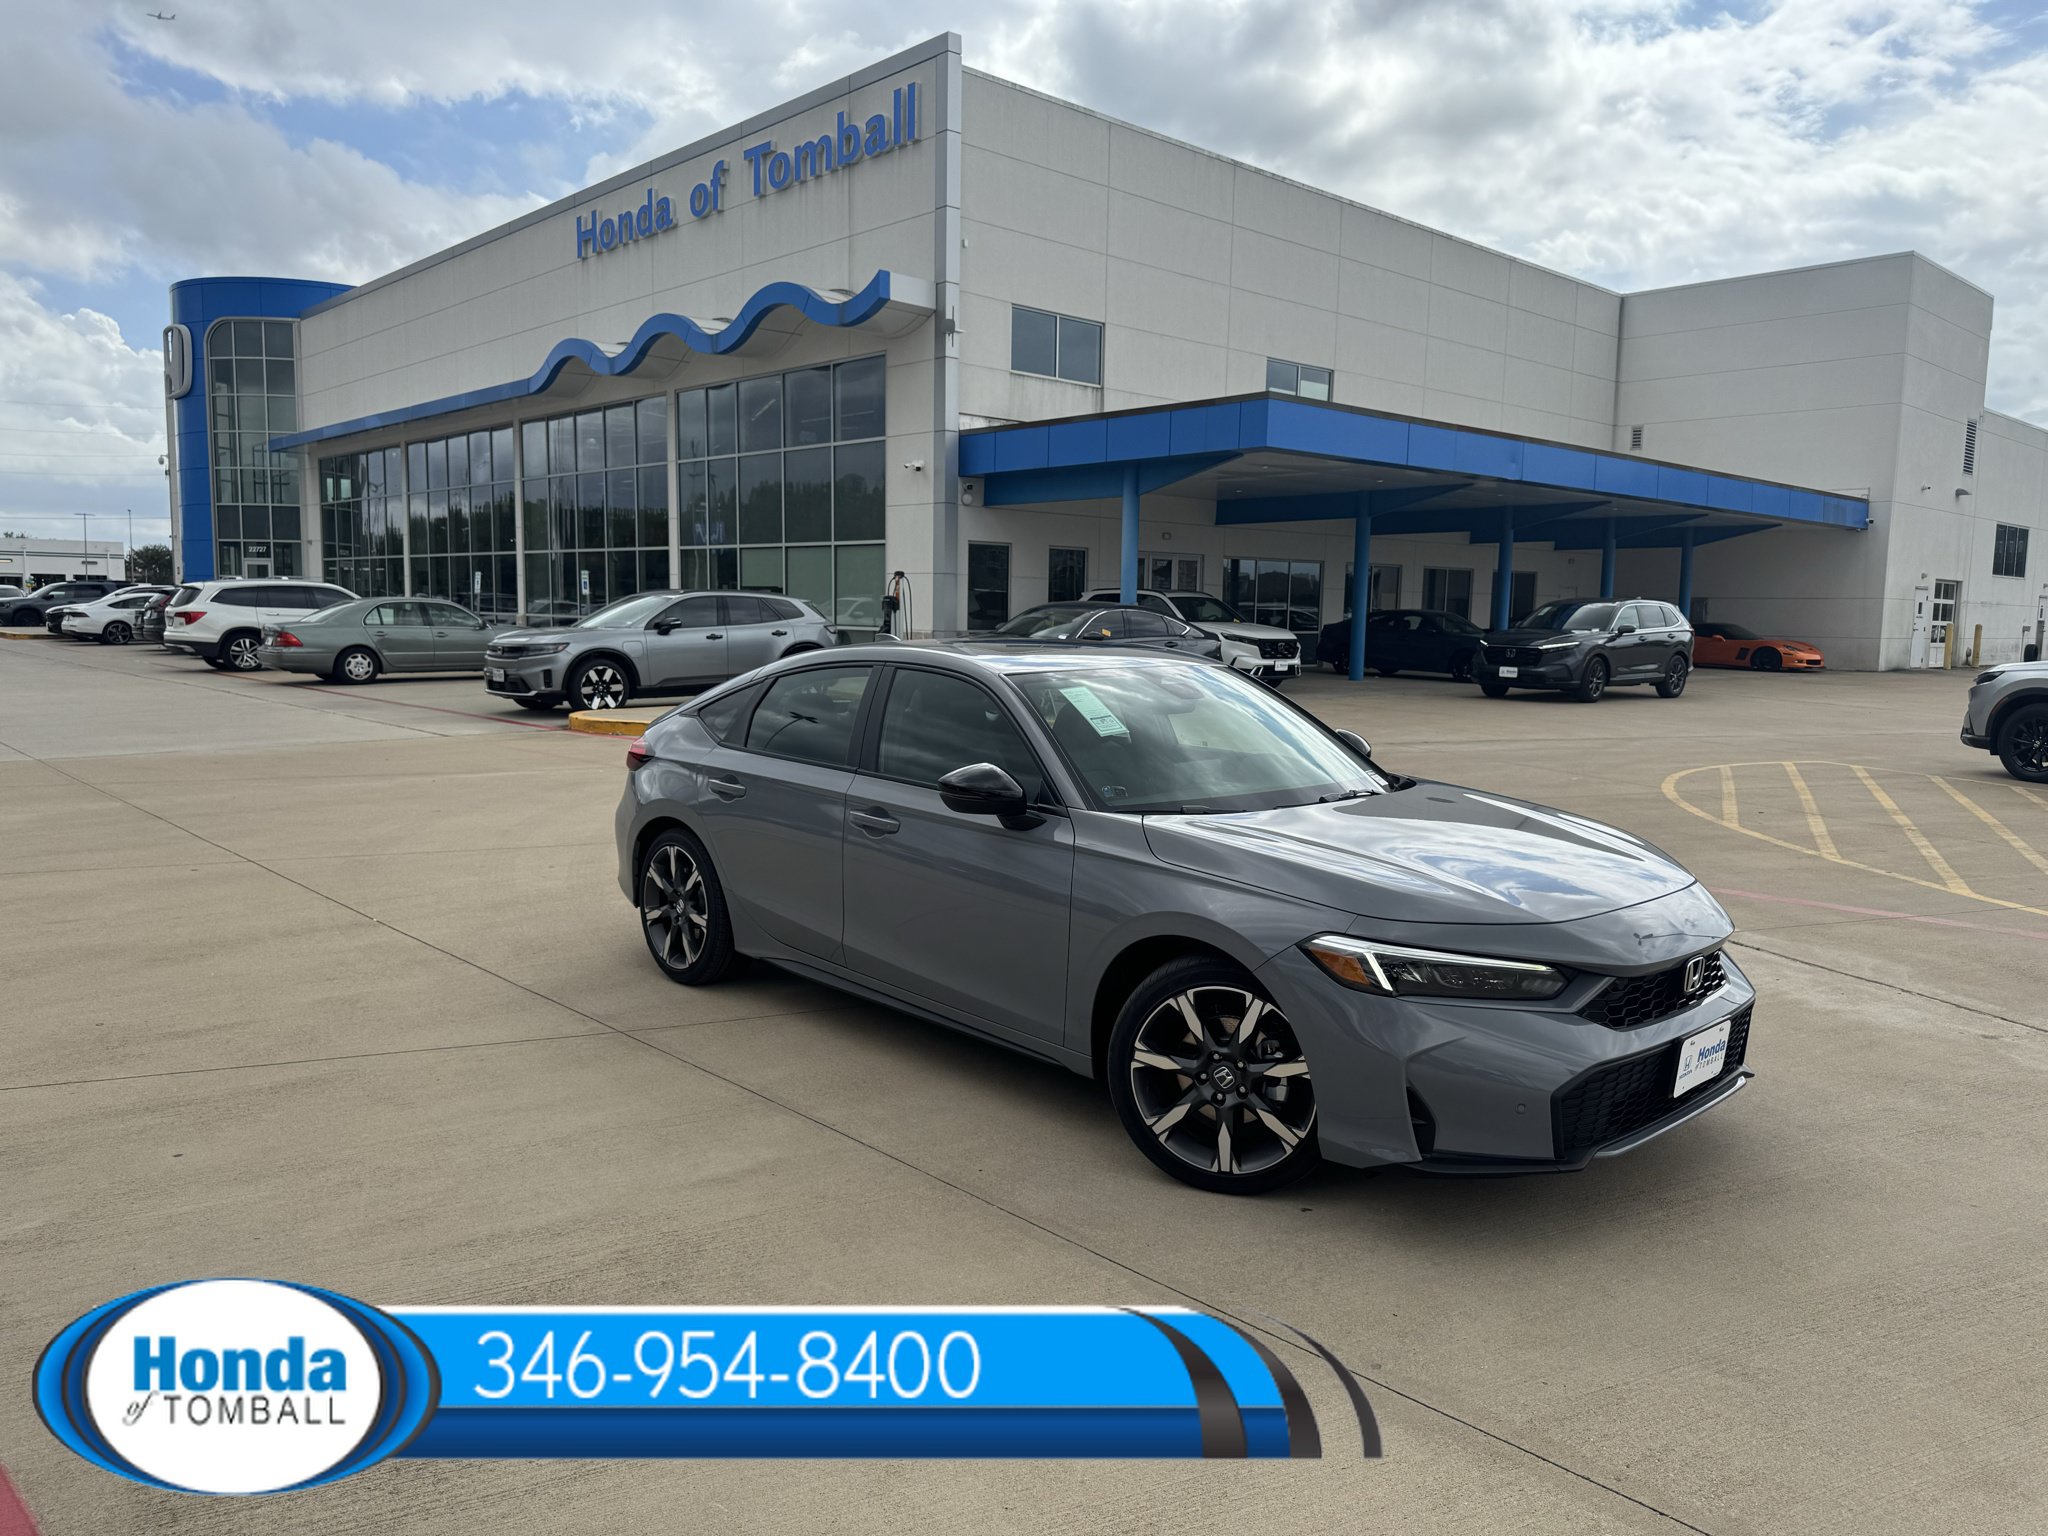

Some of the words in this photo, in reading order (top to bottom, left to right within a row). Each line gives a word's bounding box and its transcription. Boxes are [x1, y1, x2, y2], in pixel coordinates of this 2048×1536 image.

[576, 188, 677, 259] Honda
[690, 159, 729, 218] of
[743, 82, 921, 198] Tomball
[1697, 1039, 1726, 1063] Honda
